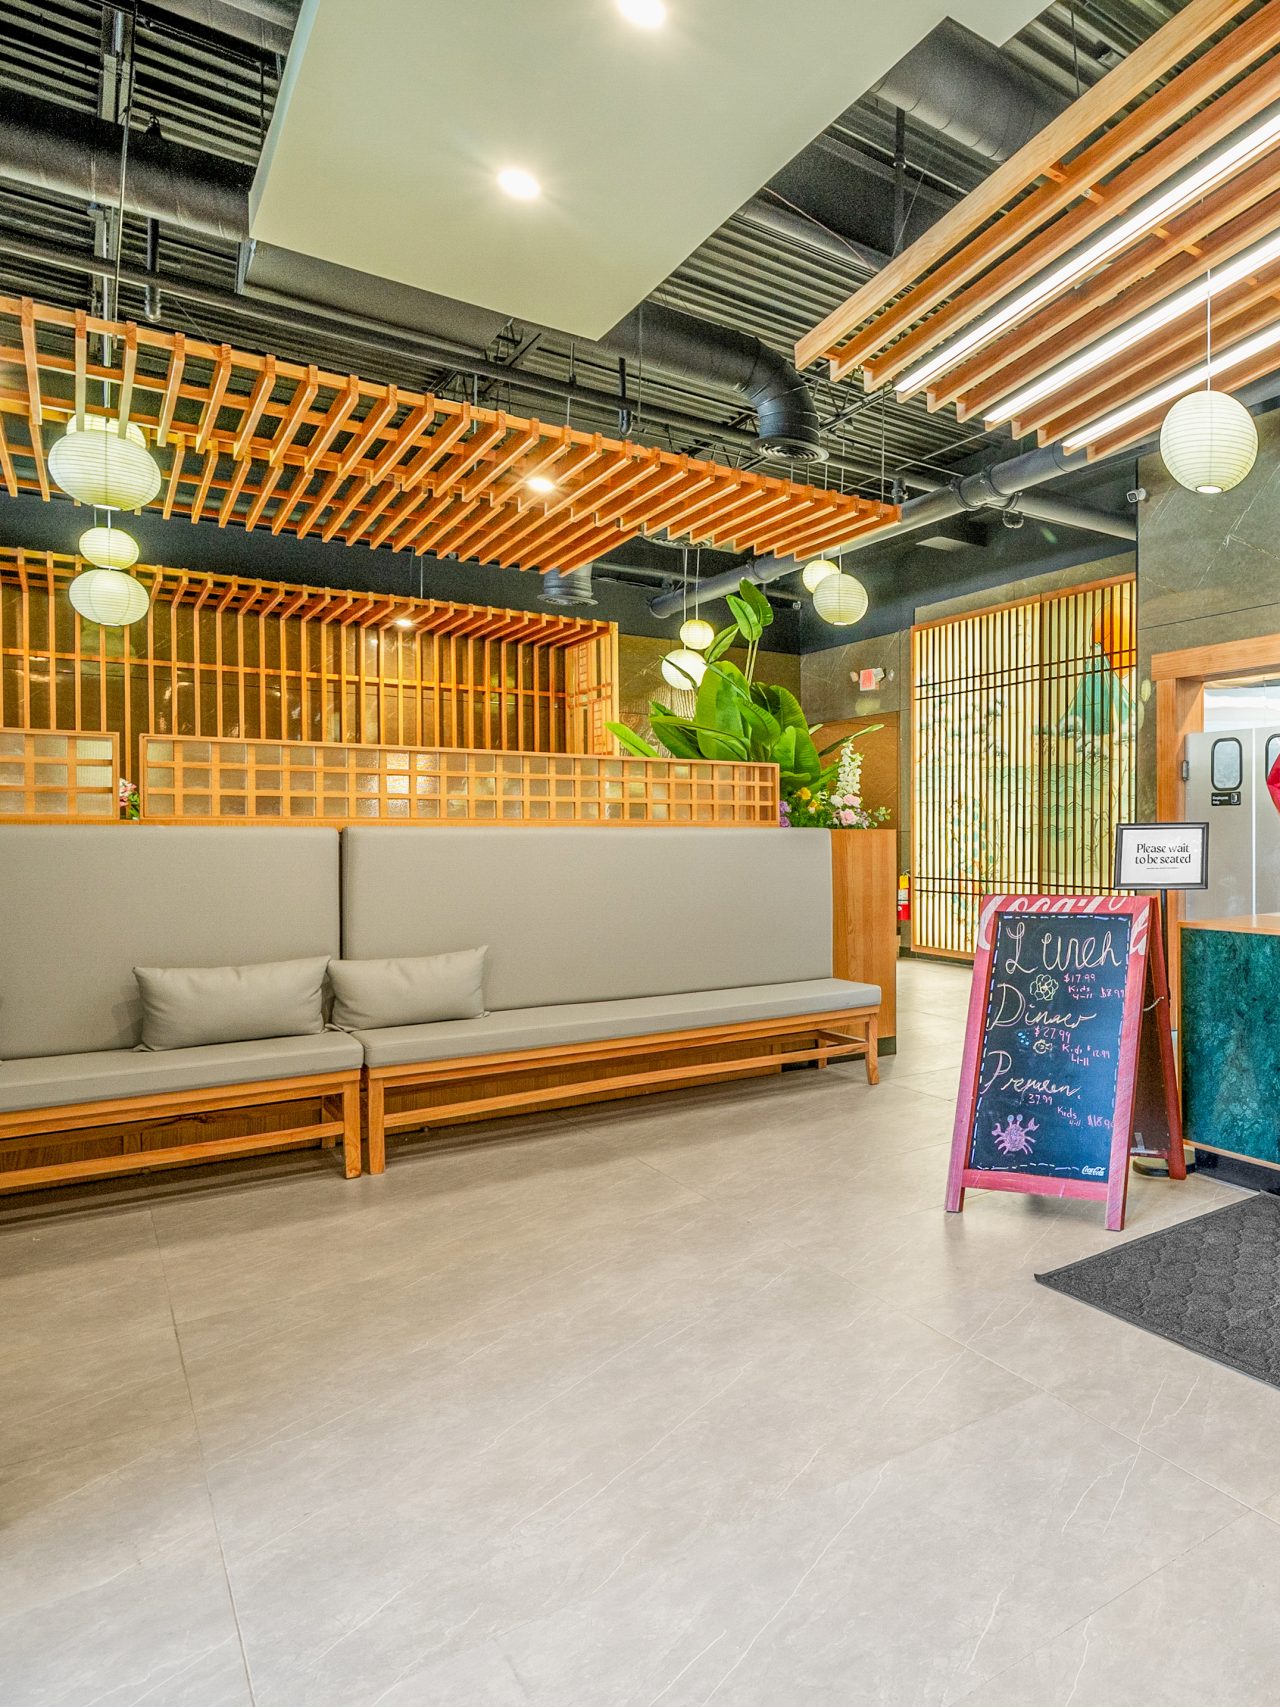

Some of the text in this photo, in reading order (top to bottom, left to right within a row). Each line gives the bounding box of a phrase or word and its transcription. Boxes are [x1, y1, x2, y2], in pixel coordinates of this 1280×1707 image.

[1136, 843, 1190, 853] Please wait
[1135, 854, 1191, 864] to be seated
